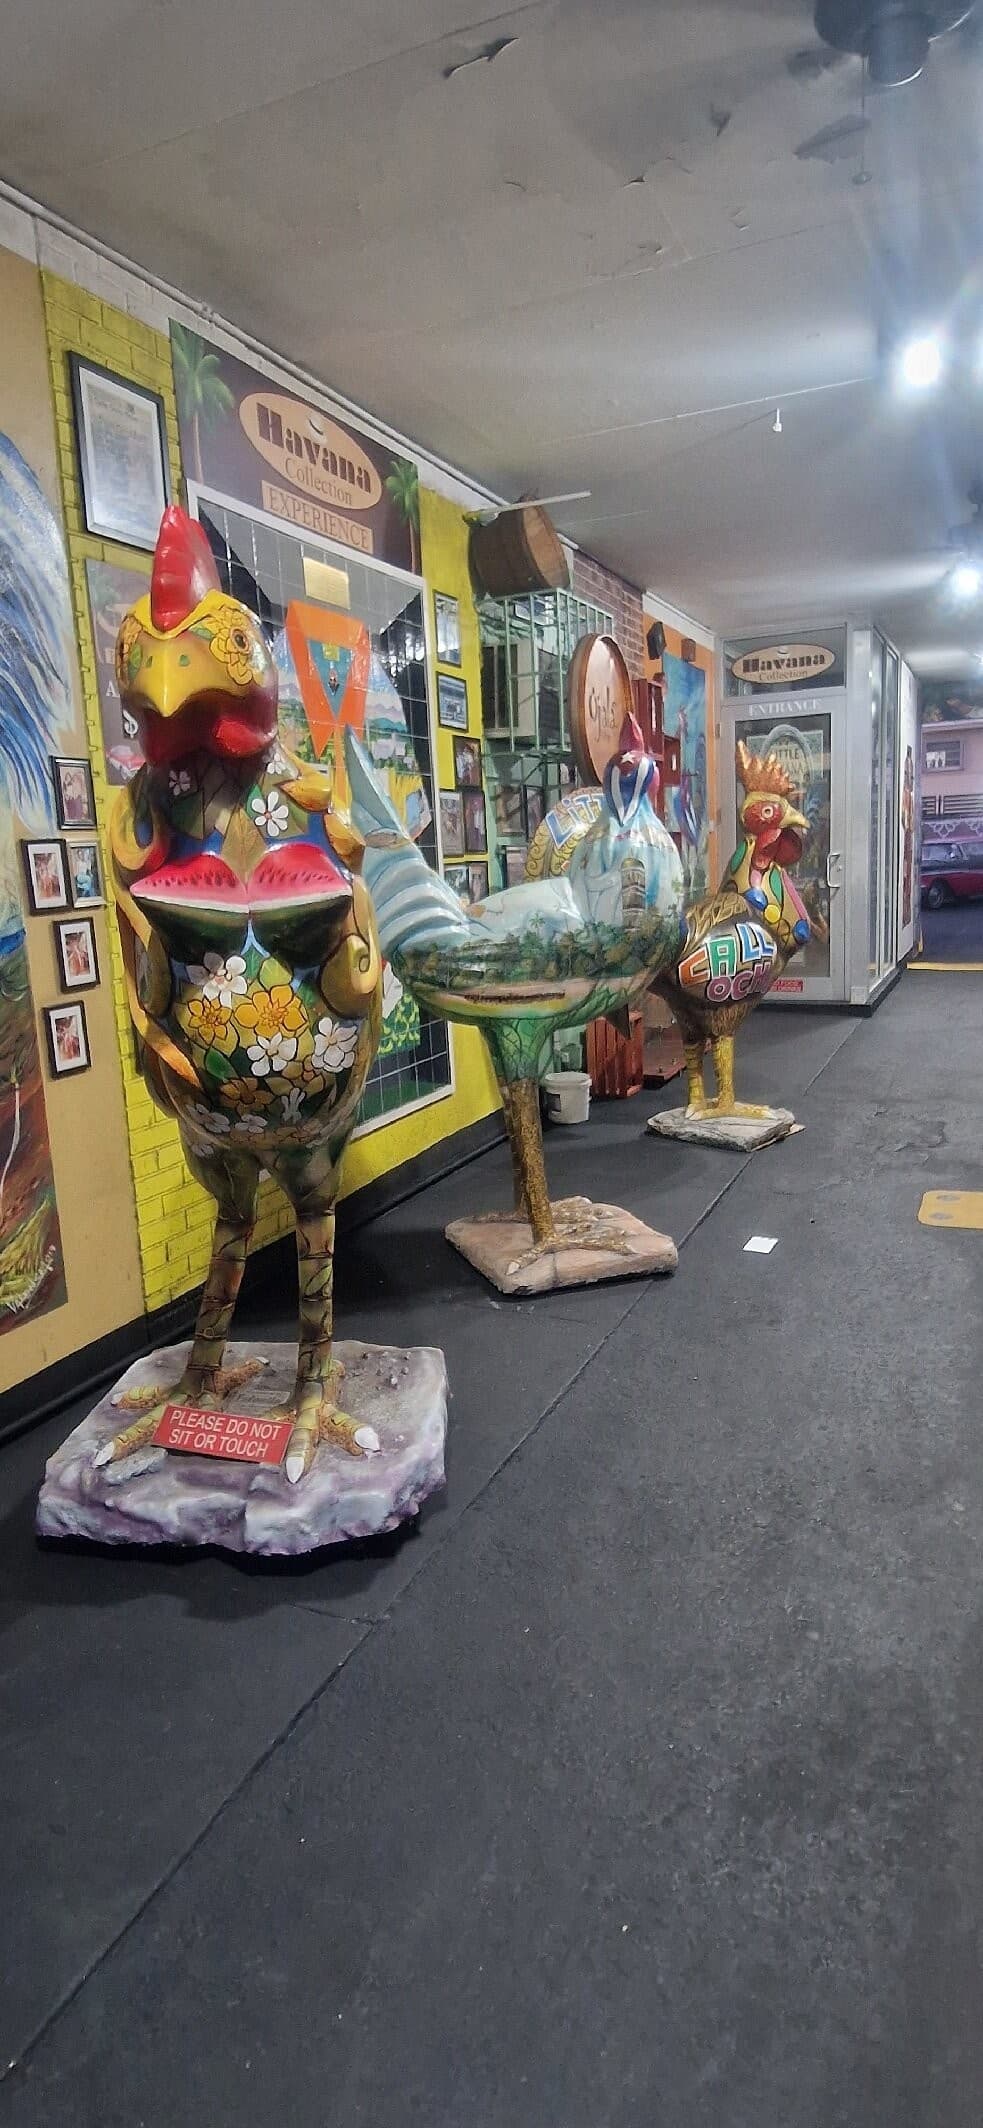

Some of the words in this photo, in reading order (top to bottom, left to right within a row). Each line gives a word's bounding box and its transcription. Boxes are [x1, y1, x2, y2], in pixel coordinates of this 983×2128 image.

[256, 402, 372, 494] Havana
[284, 457, 353, 505] Collection
[269, 487, 370, 550] EXPERIENCE
[742, 654, 826, 673] Havana
[759, 669, 808, 682] Collection
[748, 698, 824, 717] ENTRANCE
[678, 921, 778, 988] CALL
[706, 961, 773, 1002] OCH
[168, 1428, 195, 1444] SIT
[194, 1433, 217, 1451] OR
[219, 1436, 269, 1458] TOUCH
[170, 1410, 226, 1433] PLEASE
[226, 1418, 249, 1436] DO
[250, 1423, 283, 1441] NOT
